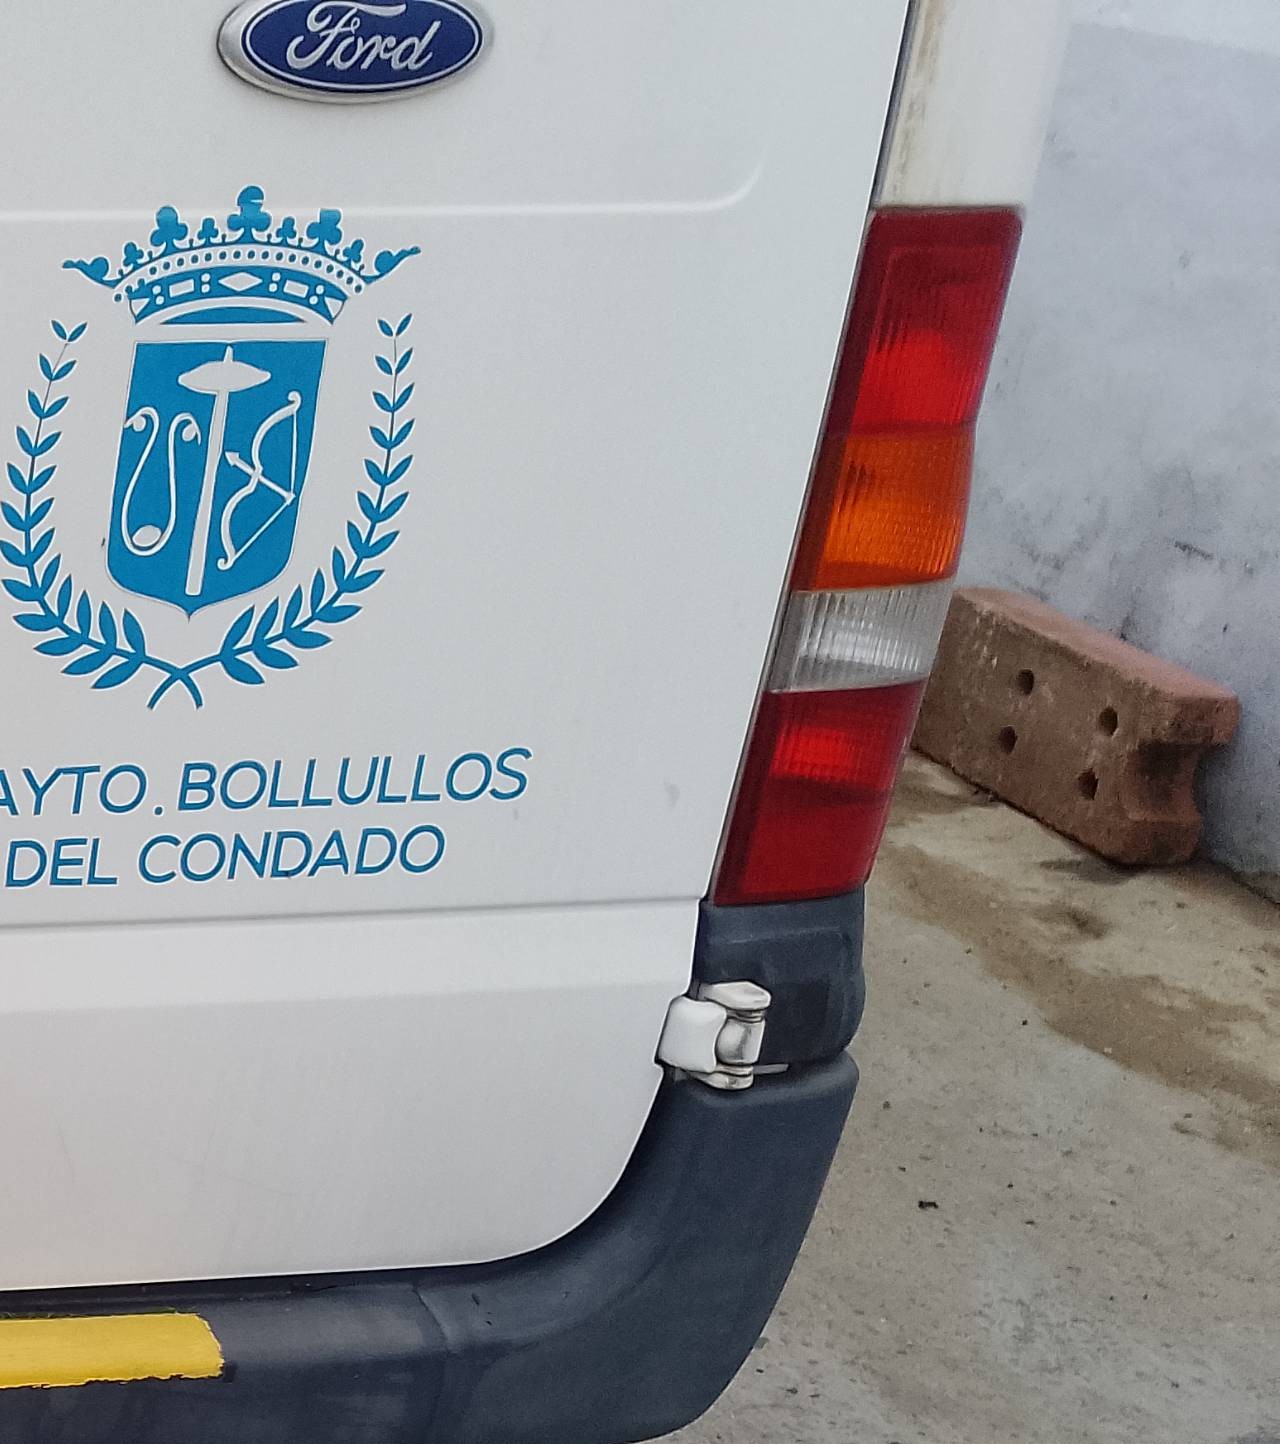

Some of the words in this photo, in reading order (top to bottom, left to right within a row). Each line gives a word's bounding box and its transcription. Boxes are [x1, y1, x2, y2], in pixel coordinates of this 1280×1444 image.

[286, 0, 441, 71] Ford
[177, 746, 535, 812] BOLLULLOS
[5, 838, 118, 889] DEL
[138, 824, 446, 885] CONDADO
